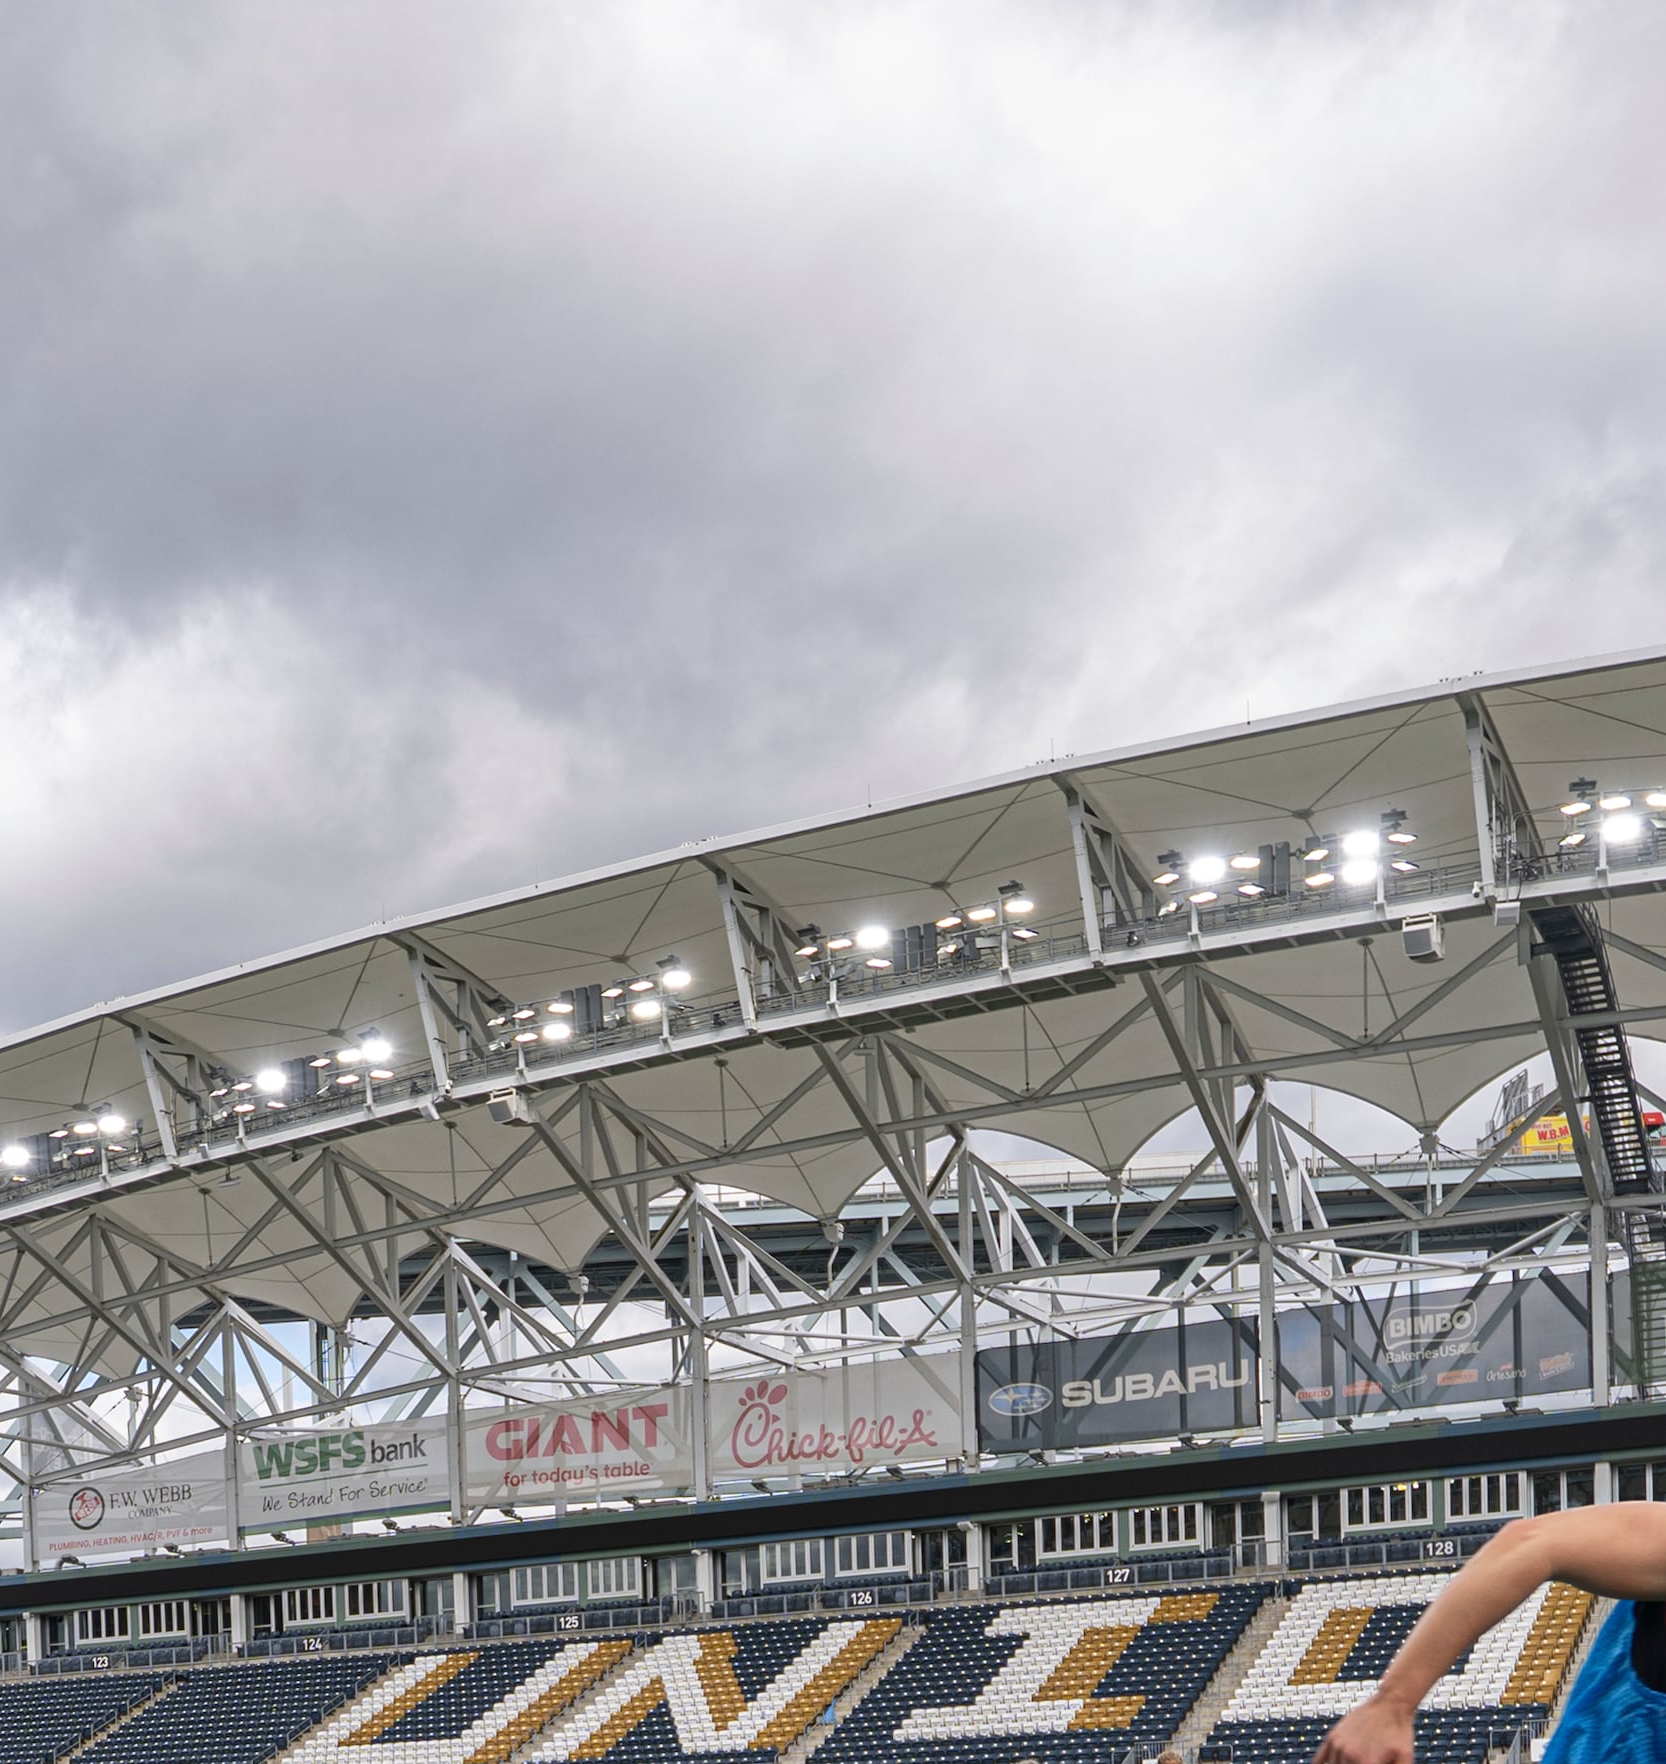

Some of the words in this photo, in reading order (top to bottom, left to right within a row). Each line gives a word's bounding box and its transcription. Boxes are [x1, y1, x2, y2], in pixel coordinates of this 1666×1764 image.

[1389, 1310, 1472, 1338] BIMBO
[1061, 1358, 1249, 1408] SUBARU
[486, 1403, 669, 1461] GIANT
[732, 1400, 939, 1469] Chick-fil-A
[253, 1431, 367, 1480] WSFS
[371, 1432, 428, 1464] bank
[503, 1471, 527, 1487] for
[531, 1464, 599, 1485] today's
[603, 1461, 651, 1478] table
[142, 1484, 193, 1504] WEBB
[262, 1496, 283, 1513] We
[288, 1488, 333, 1510] Stand
[339, 1485, 365, 1502] For
[370, 1478, 426, 1498] Service
[128, 1505, 173, 1520] COMPANY
[190, 1526, 213, 1536] more
[1426, 1540, 1454, 1556] 128
[1106, 1568, 1130, 1583] 127
[850, 1591, 873, 1606] 126
[558, 1615, 579, 1630] 125
[302, 1638, 323, 1651] 124
[91, 1656, 110, 1669] 123
